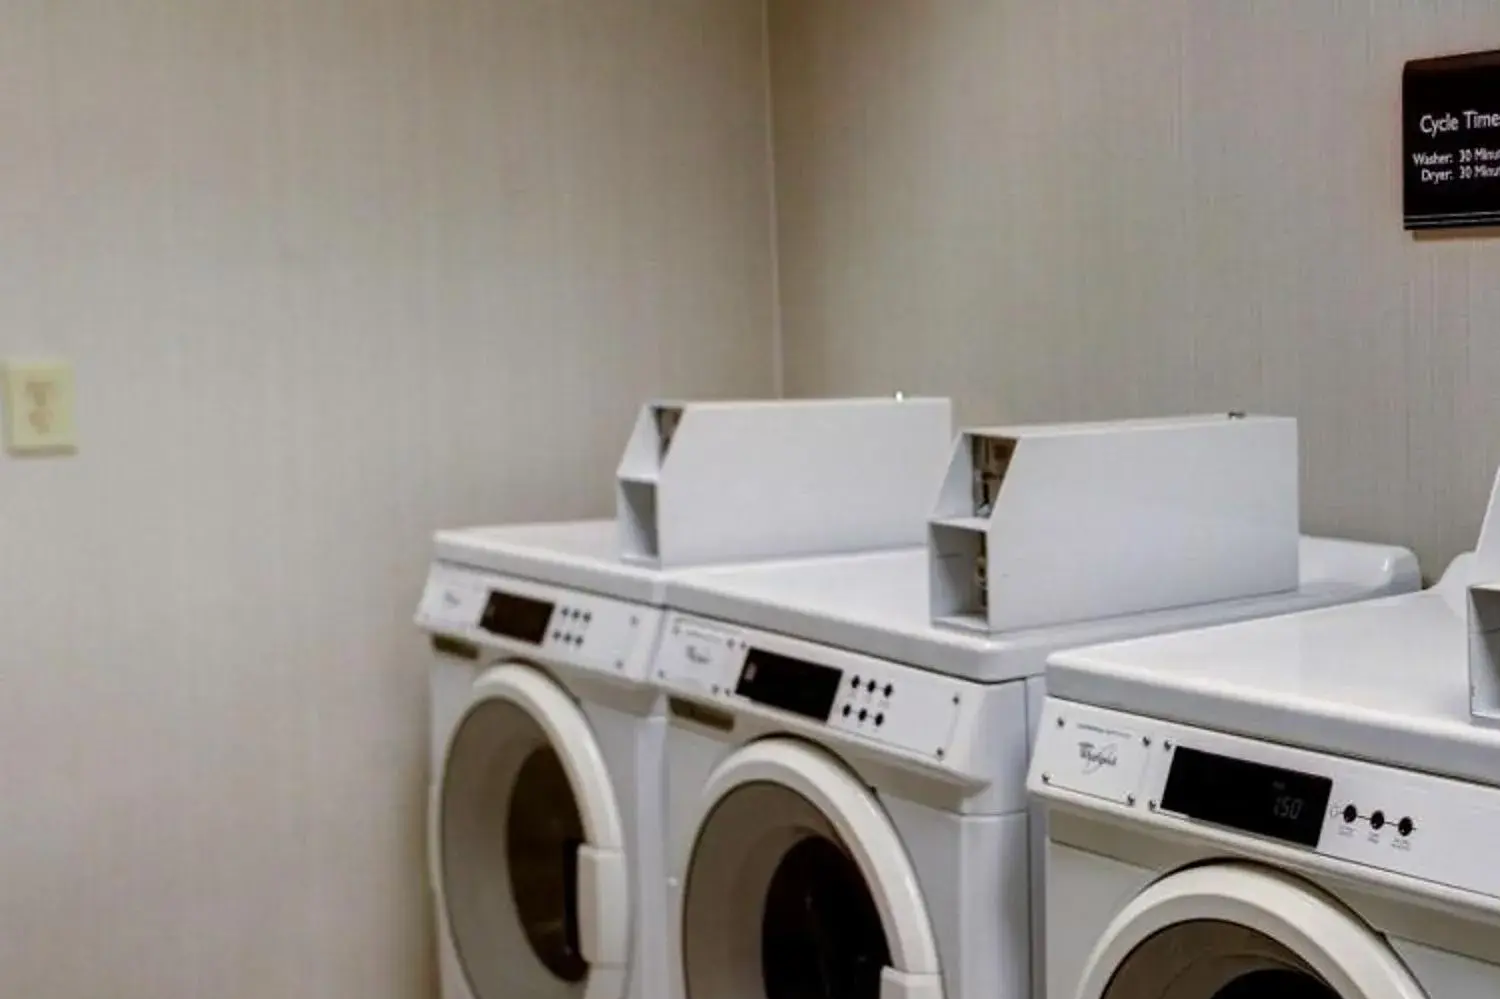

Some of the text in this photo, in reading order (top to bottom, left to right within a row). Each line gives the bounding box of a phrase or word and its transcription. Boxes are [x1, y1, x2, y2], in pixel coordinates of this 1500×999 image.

[1420, 112, 1459, 138] Cycle
[1459, 148, 1472, 162] 30
[1459, 165, 1472, 179] 30
